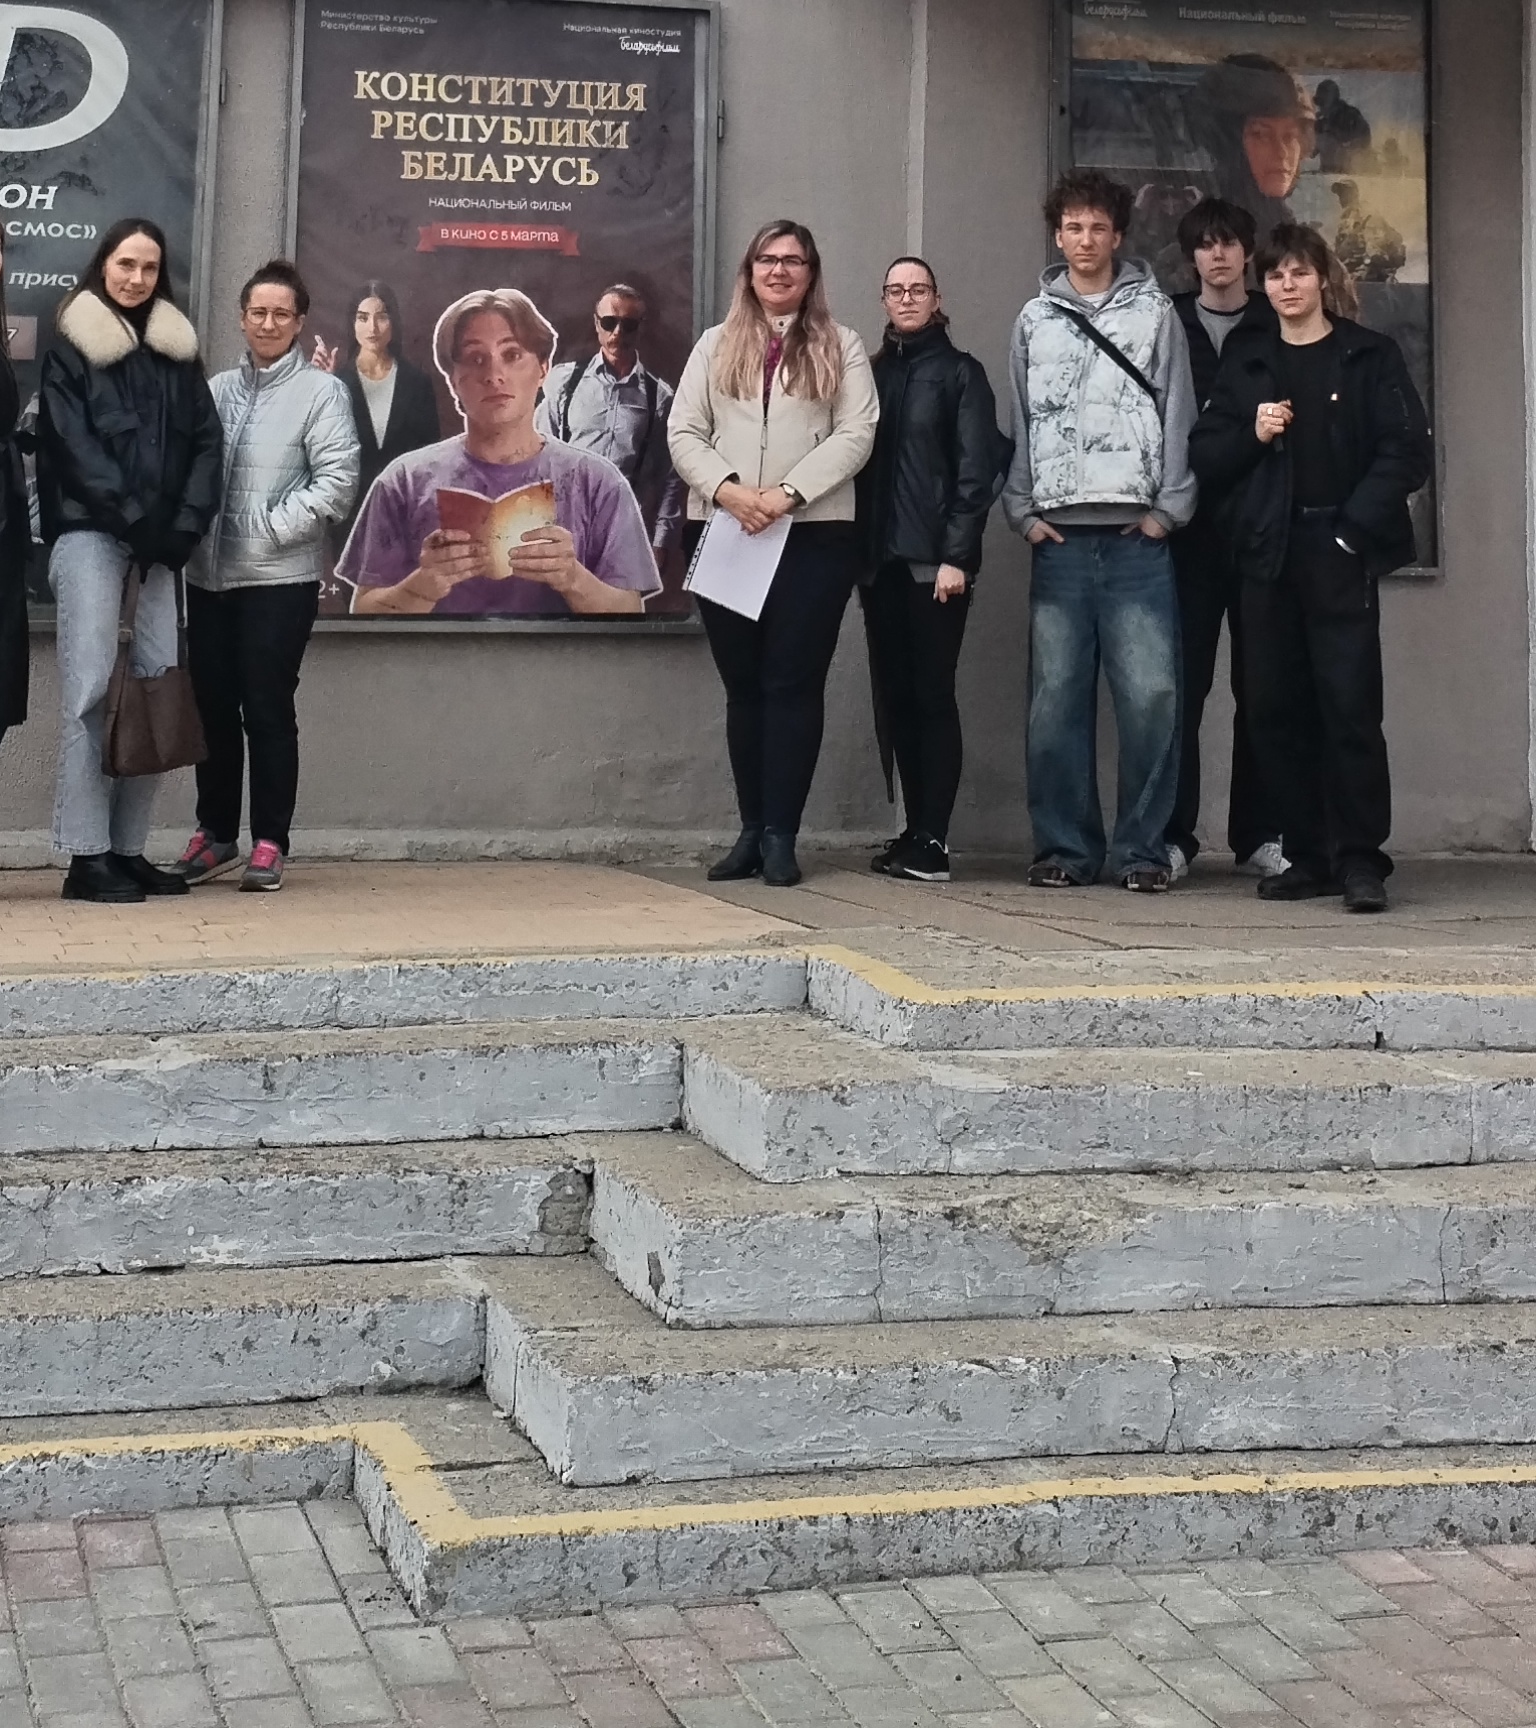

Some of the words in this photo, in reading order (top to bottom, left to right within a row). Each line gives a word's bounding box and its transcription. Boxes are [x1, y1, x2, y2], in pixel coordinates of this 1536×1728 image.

[320, 10, 391, 23] Министерство
[392, 15, 438, 25] культуры
[1178, 6, 1266, 23] Национальный
[320, 20, 377, 32] Республики
[379, 23, 425, 35] Беларусь
[563, 22, 628, 34] Национальная
[629, 27, 682, 38] киностудия
[353, 70, 648, 116] КОНСТИТУЦИЯ
[370, 110, 630, 149] РЕСПУБЛИКИ
[400, 150, 600, 186] БЕЛАРУСЬ
[428, 197, 528, 210] НАЦИОНАЛЬНЫЙ
[530, 200, 572, 212] ФИЛЬМ
[501, 230, 509, 241] 5
